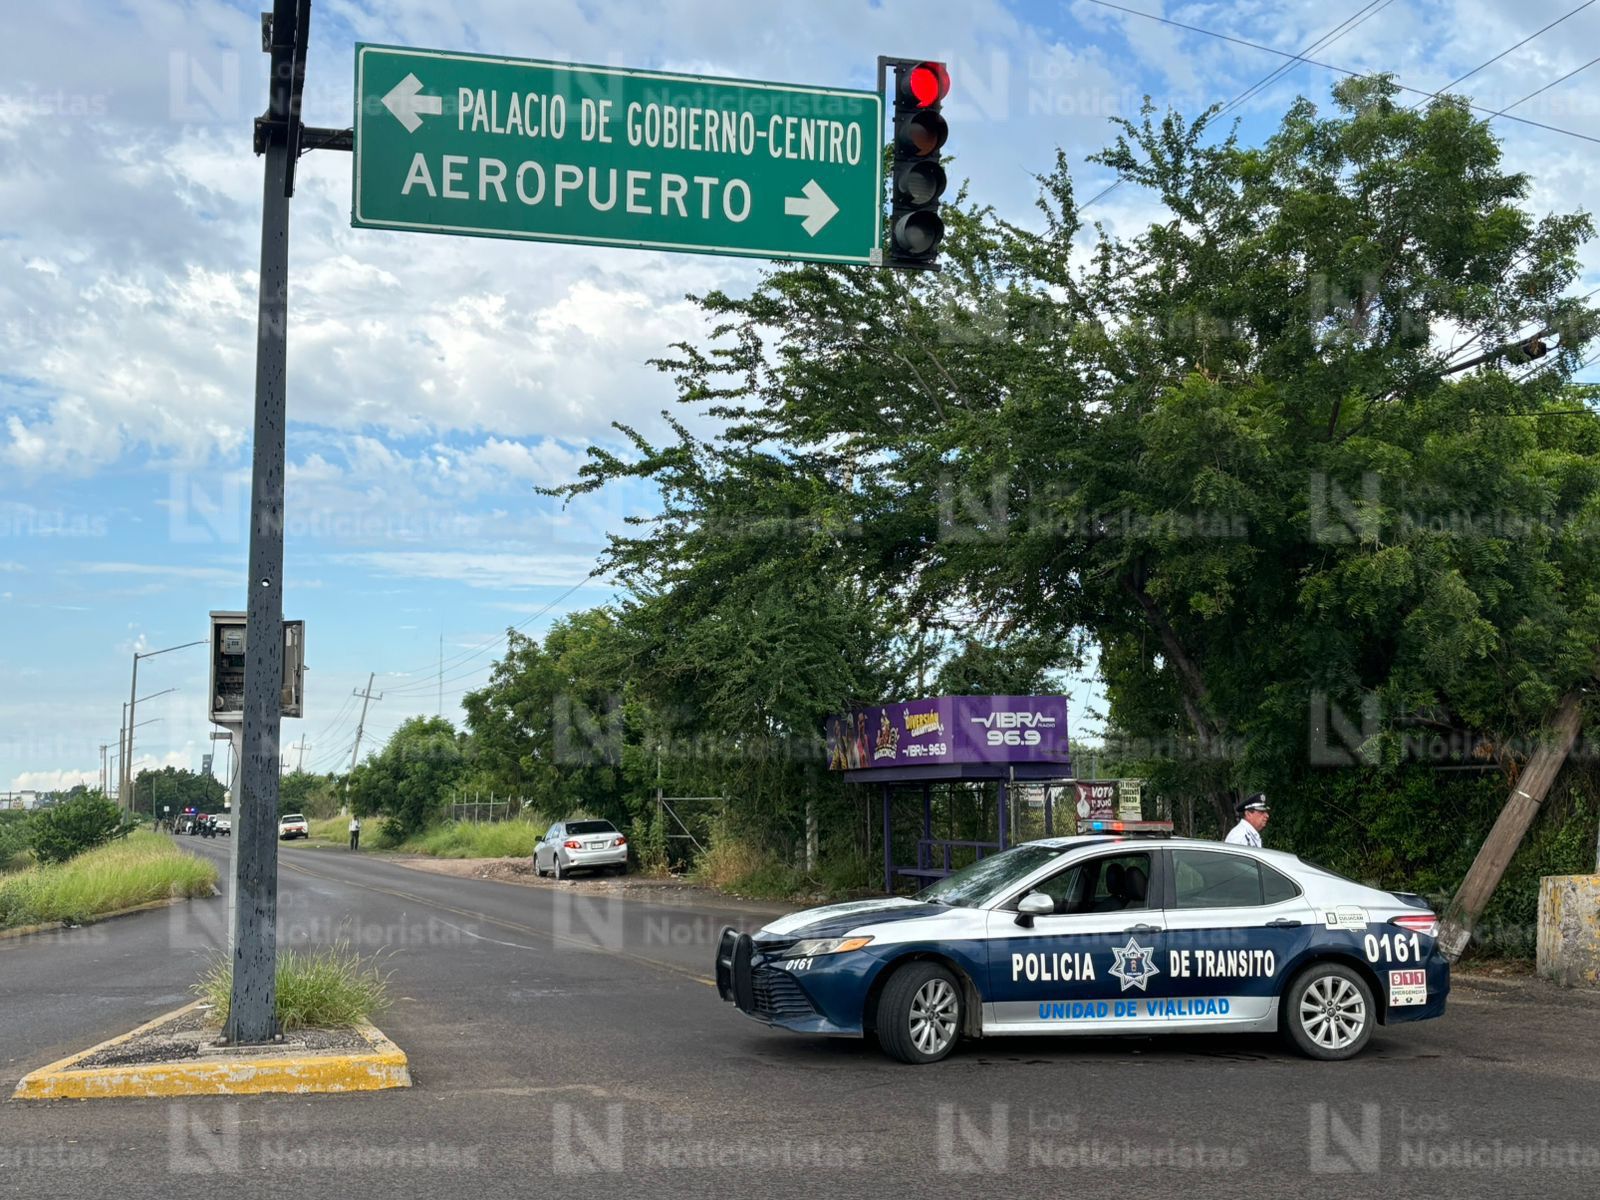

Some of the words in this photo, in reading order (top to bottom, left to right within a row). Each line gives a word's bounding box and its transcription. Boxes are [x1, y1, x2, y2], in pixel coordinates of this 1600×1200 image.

[458, 87, 566, 140] PALACIO
[580, 98, 613, 143] DE
[627, 101, 862, 166] GOBIERNO-CENTRO
[401, 152, 751, 223] AEROPUERTO
[971, 712, 1056, 728] VIBRA
[987, 730, 1041, 746] 96.9
[929, 743, 947, 756] 96.9
[1364, 933, 1420, 963] 0161
[785, 958, 814, 971] 0161
[1012, 952, 1096, 981] POLICIA
[1170, 950, 1191, 978] DE
[1195, 950, 1275, 978] TRANSITO
[1392, 972, 1424, 985] 911
[1039, 1001, 1111, 1019] UNIDAD
[1114, 1000, 1137, 1018] DE
[1147, 998, 1230, 1017] VIALIDAD
